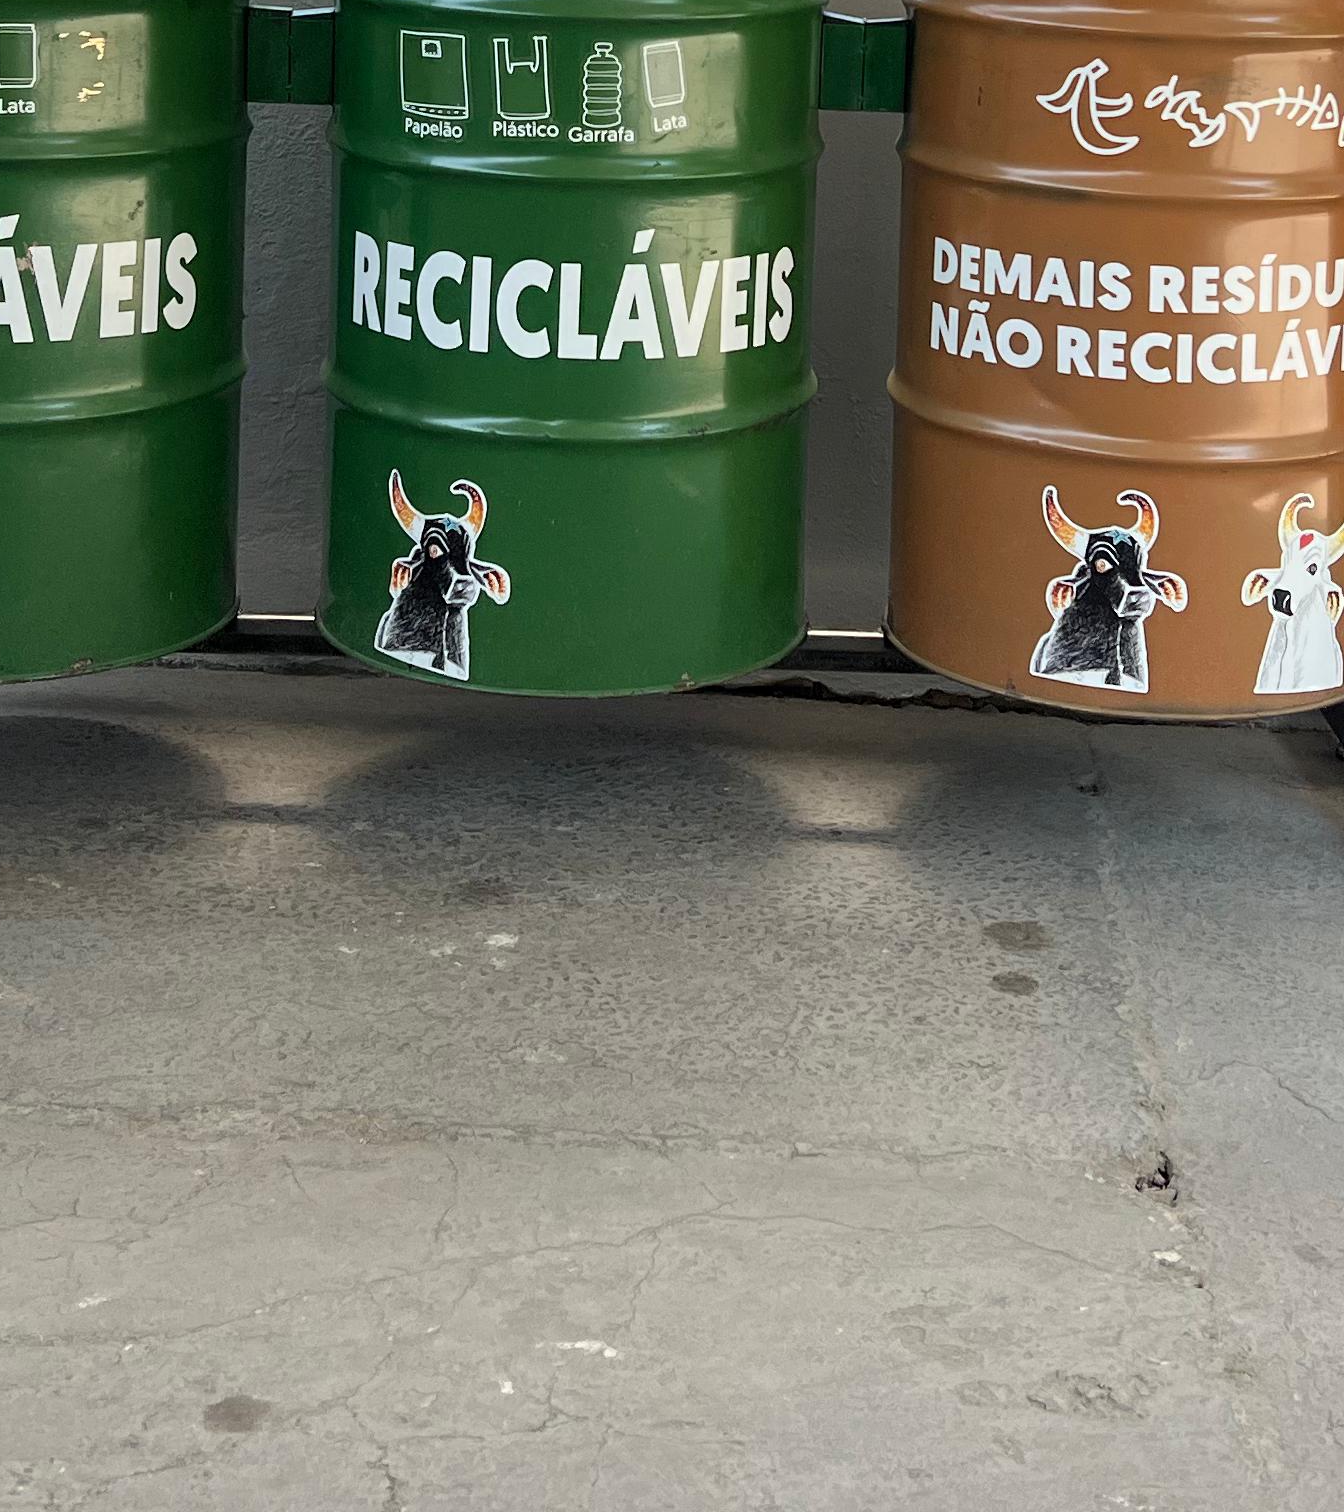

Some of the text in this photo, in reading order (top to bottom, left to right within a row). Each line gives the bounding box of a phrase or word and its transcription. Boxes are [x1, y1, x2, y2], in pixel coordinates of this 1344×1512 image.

[404, 112, 687, 144] Papelão Plástico Garrafa Lata
[352, 229, 795, 361] RECICLÁVEIS
[933, 236, 1132, 312] DEMAIS
[930, 300, 1044, 369] NÃO
